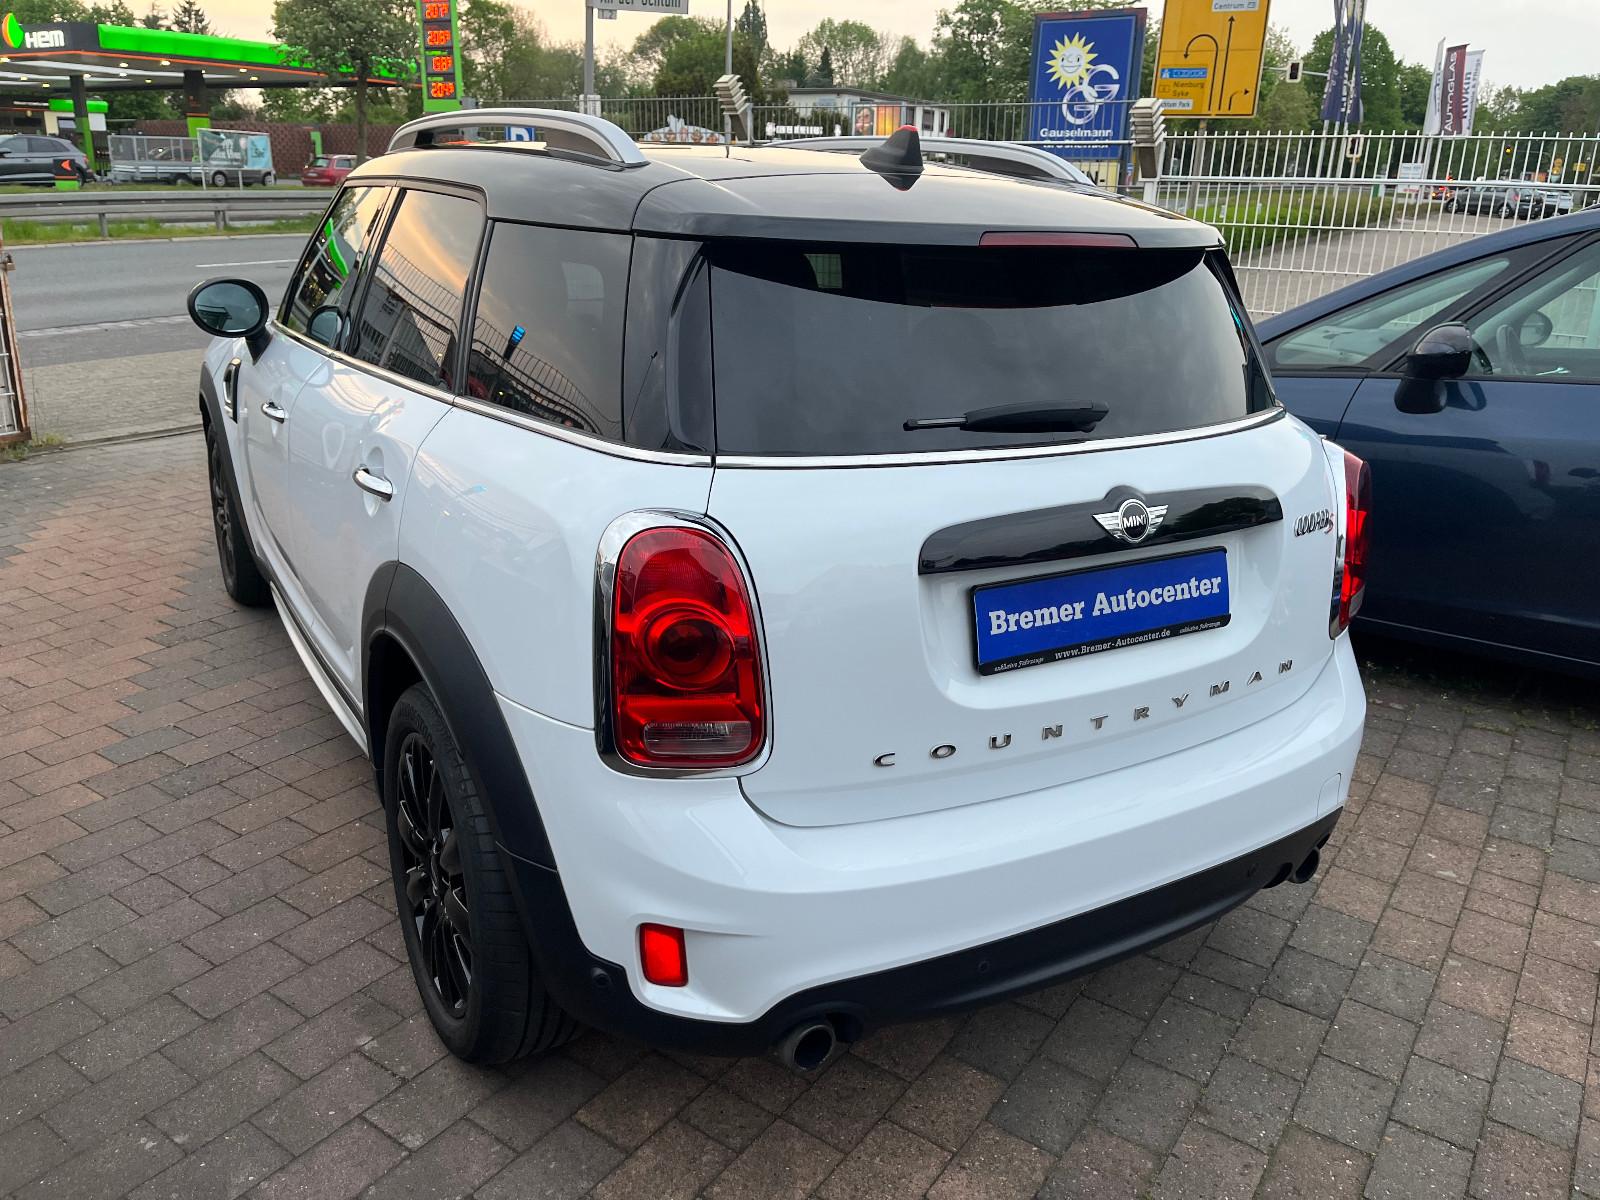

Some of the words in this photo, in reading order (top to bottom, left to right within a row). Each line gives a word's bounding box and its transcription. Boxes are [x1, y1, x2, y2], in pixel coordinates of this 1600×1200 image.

[1040, 128, 1113, 138] Gauselmann
[1123, 514, 1147, 529] MINI
[989, 600, 1085, 636] Bremer
[1092, 576, 1222, 617] Autocenter
[1055, 628, 1171, 660] www.Bremer-Autocenter.de
[872, 658, 1294, 768] COUNTRYMAN
